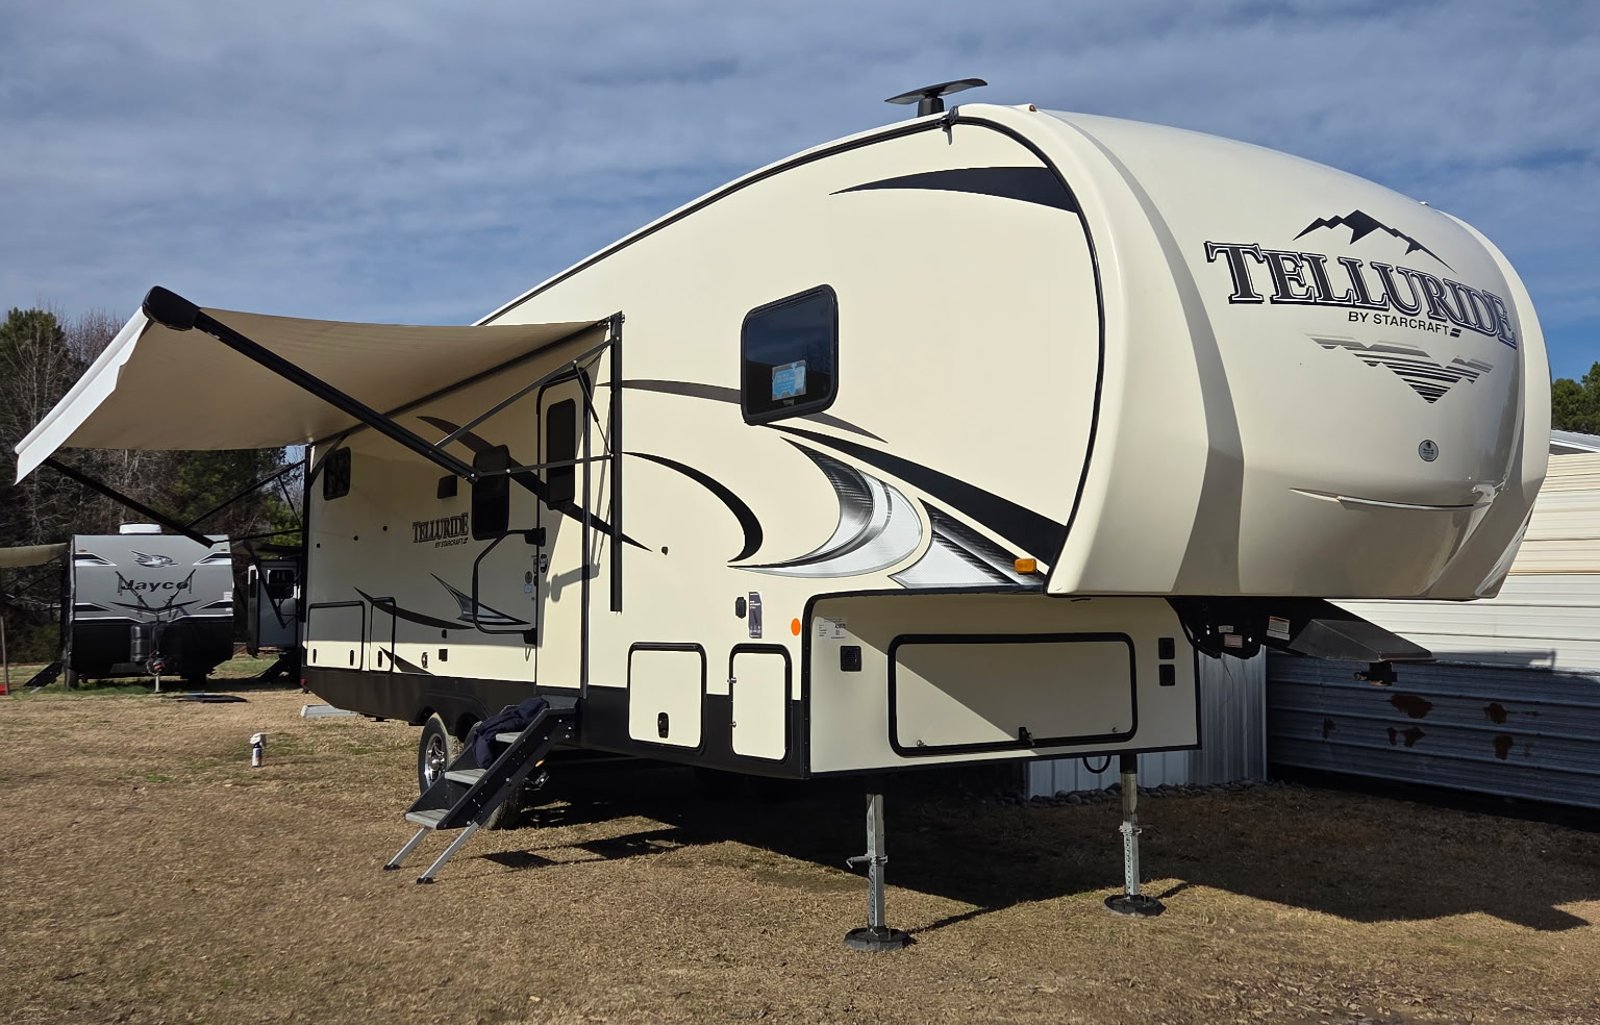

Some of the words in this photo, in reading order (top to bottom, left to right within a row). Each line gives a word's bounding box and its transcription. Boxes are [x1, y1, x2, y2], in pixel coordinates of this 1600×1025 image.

[1204, 241, 1517, 349] TELLURIDE
[1348, 311, 1369, 322] BY
[1373, 313, 1449, 335] STARCRAFT
[412, 512, 468, 543] TELLURIDE
[121, 579, 189, 592] Jayco
